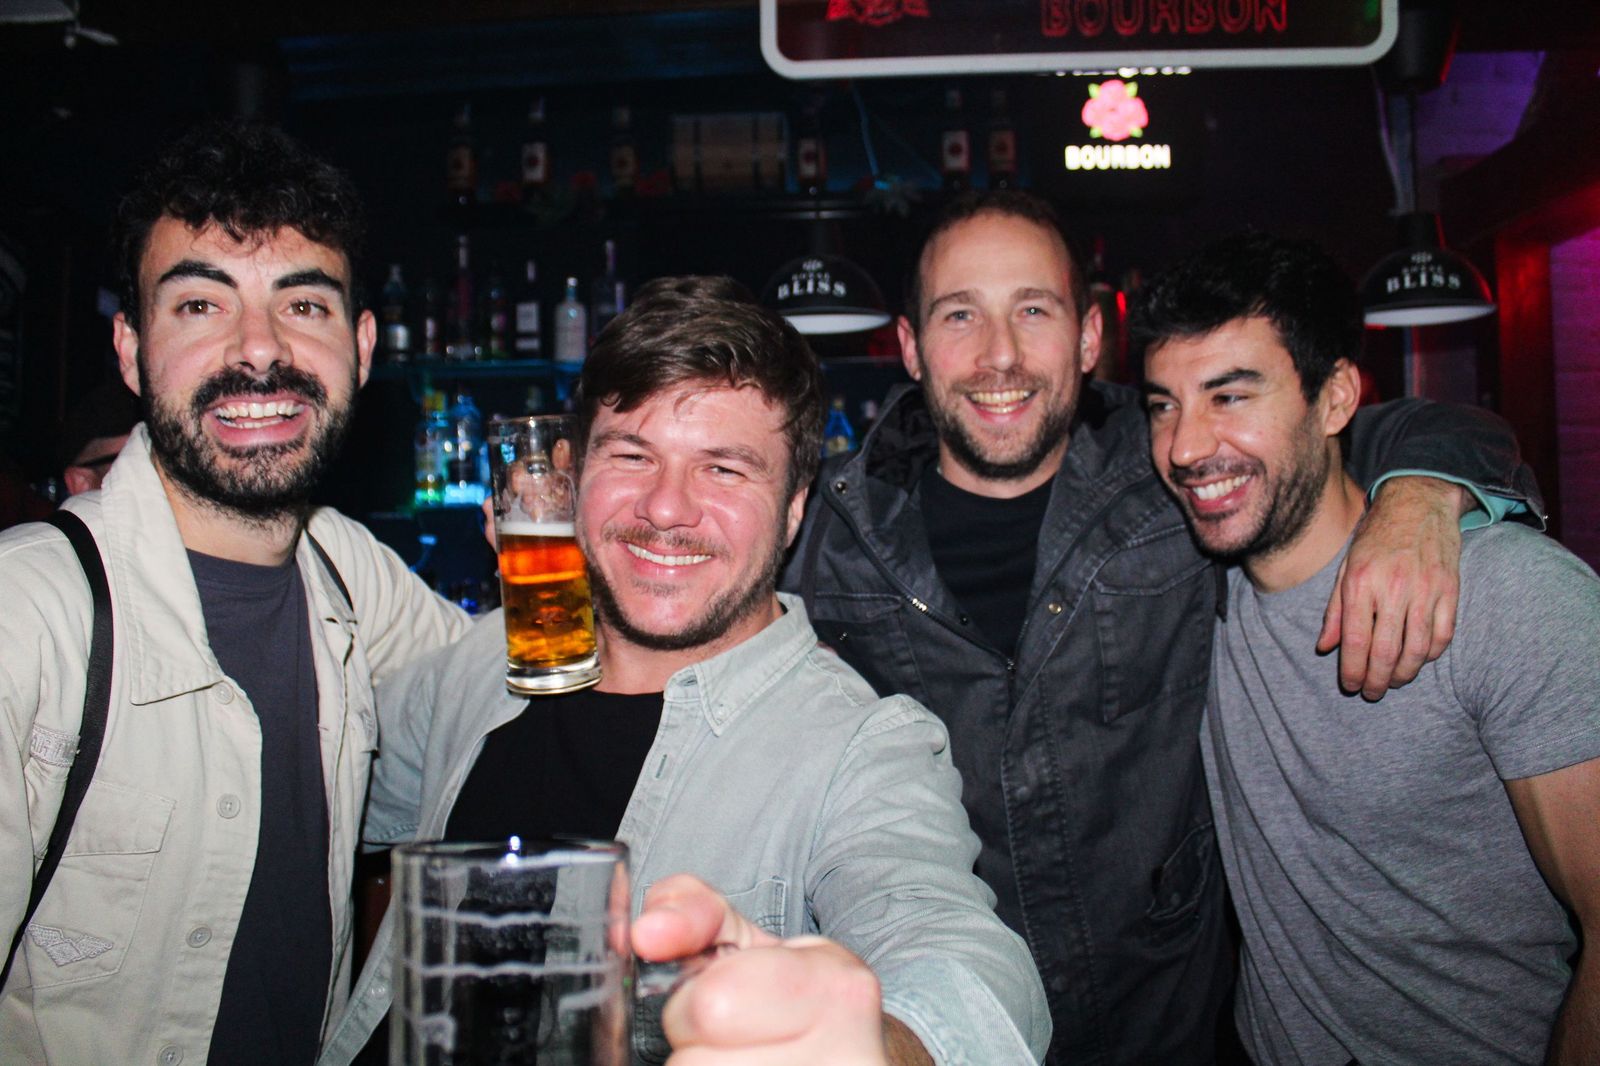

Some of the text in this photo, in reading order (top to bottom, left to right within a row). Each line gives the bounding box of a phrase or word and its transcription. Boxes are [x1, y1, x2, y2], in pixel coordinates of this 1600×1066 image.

[1041, 0, 1289, 37] BOURBON
[1065, 144, 1171, 170] BOURBON
[777, 278, 847, 300] BLISS
[1386, 271, 1461, 293] BLISS
